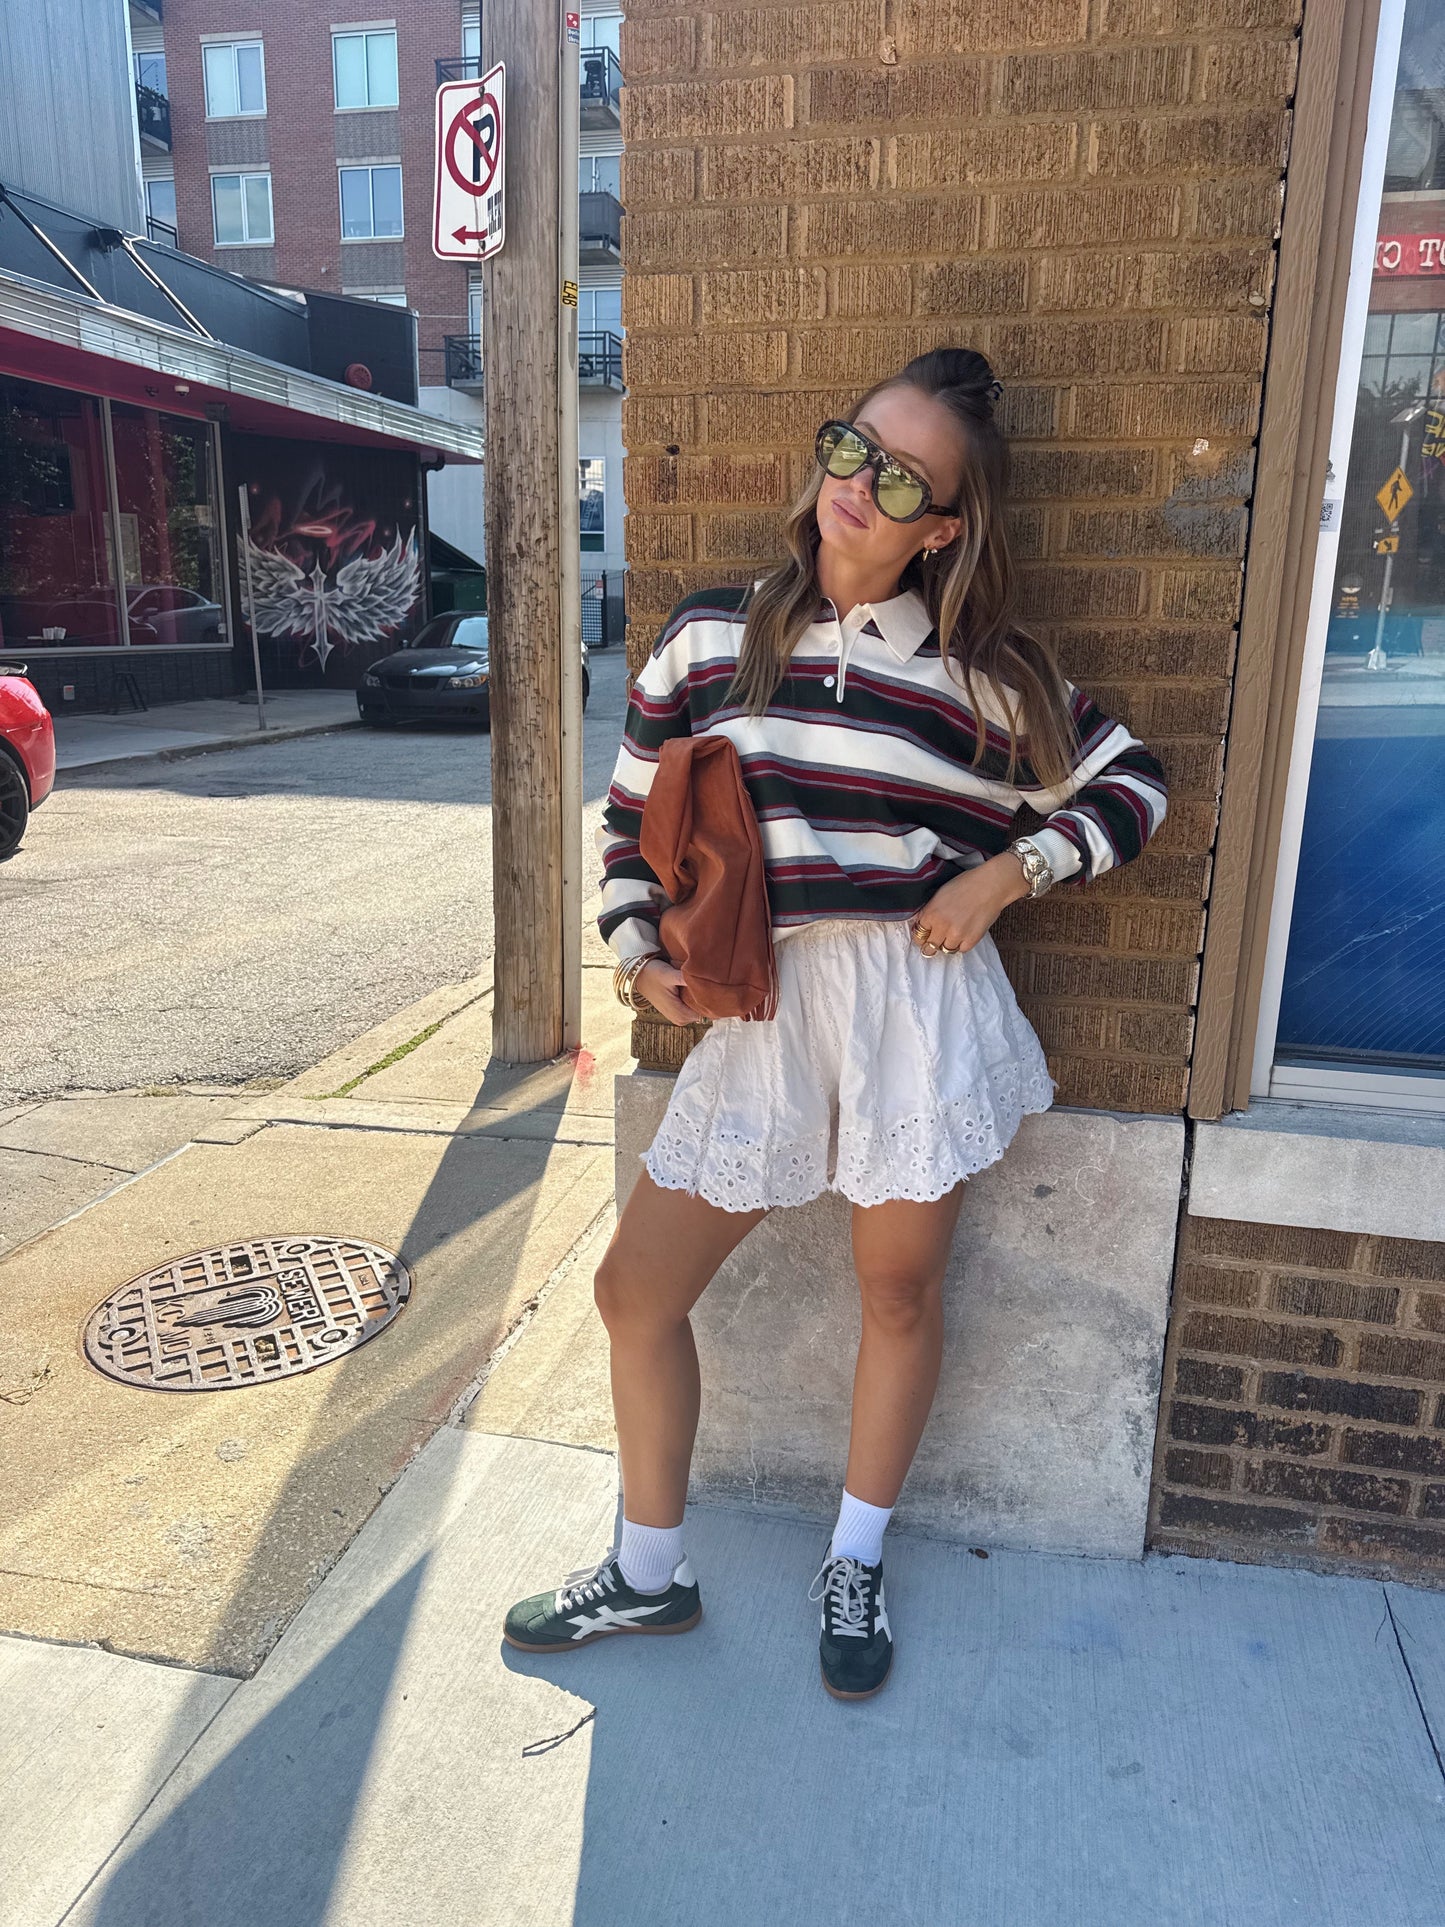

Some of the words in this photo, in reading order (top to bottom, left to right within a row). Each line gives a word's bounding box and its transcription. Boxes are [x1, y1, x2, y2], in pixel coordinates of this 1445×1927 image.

[277, 1268, 321, 1323] SEWER
[154, 1299, 186, 1323] KC
[159, 1329, 192, 1355] MO
